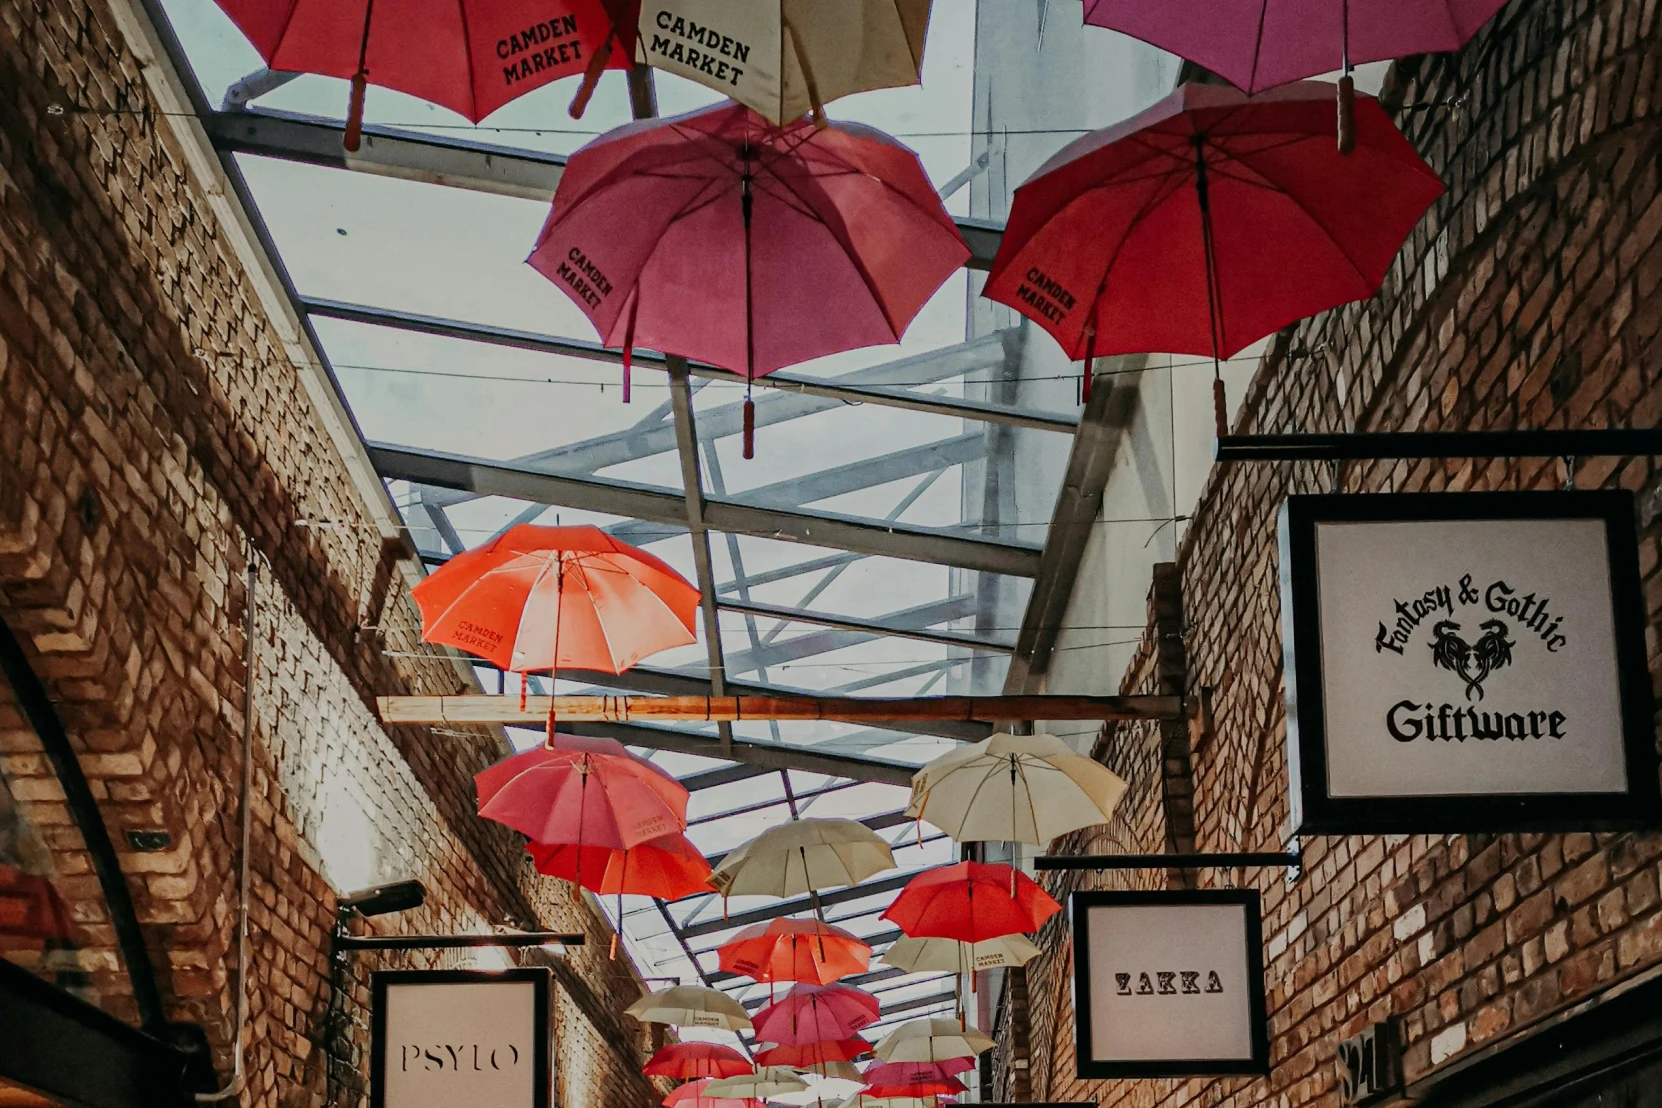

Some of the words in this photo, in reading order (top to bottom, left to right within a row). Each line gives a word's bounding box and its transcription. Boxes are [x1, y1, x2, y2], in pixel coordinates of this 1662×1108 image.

[496, 14, 578, 59] CAMDEN
[656, 10, 751, 64] CAMDEN
[503, 40, 582, 85] MARKET
[651, 34, 744, 86] MARKET
[556, 261, 601, 311] MARKET
[568, 247, 613, 297] CAMDEN
[1027, 267, 1076, 310] CAMDEN
[1016, 283, 1066, 325] MARKET
[458, 620, 504, 643] CAMDEN
[1375, 584, 1454, 656] Fantasy
[1458, 573, 1479, 605] &
[1485, 580, 1566, 653] Gothic
[452, 630, 497, 652] MARKET
[1386, 699, 1567, 743] Giftware
[976, 953, 1003, 962] CAMDEN
[978, 959, 1005, 967] MARKET
[1115, 970, 1224, 996] ZAKKA
[402, 1044, 519, 1072] PSYLO
